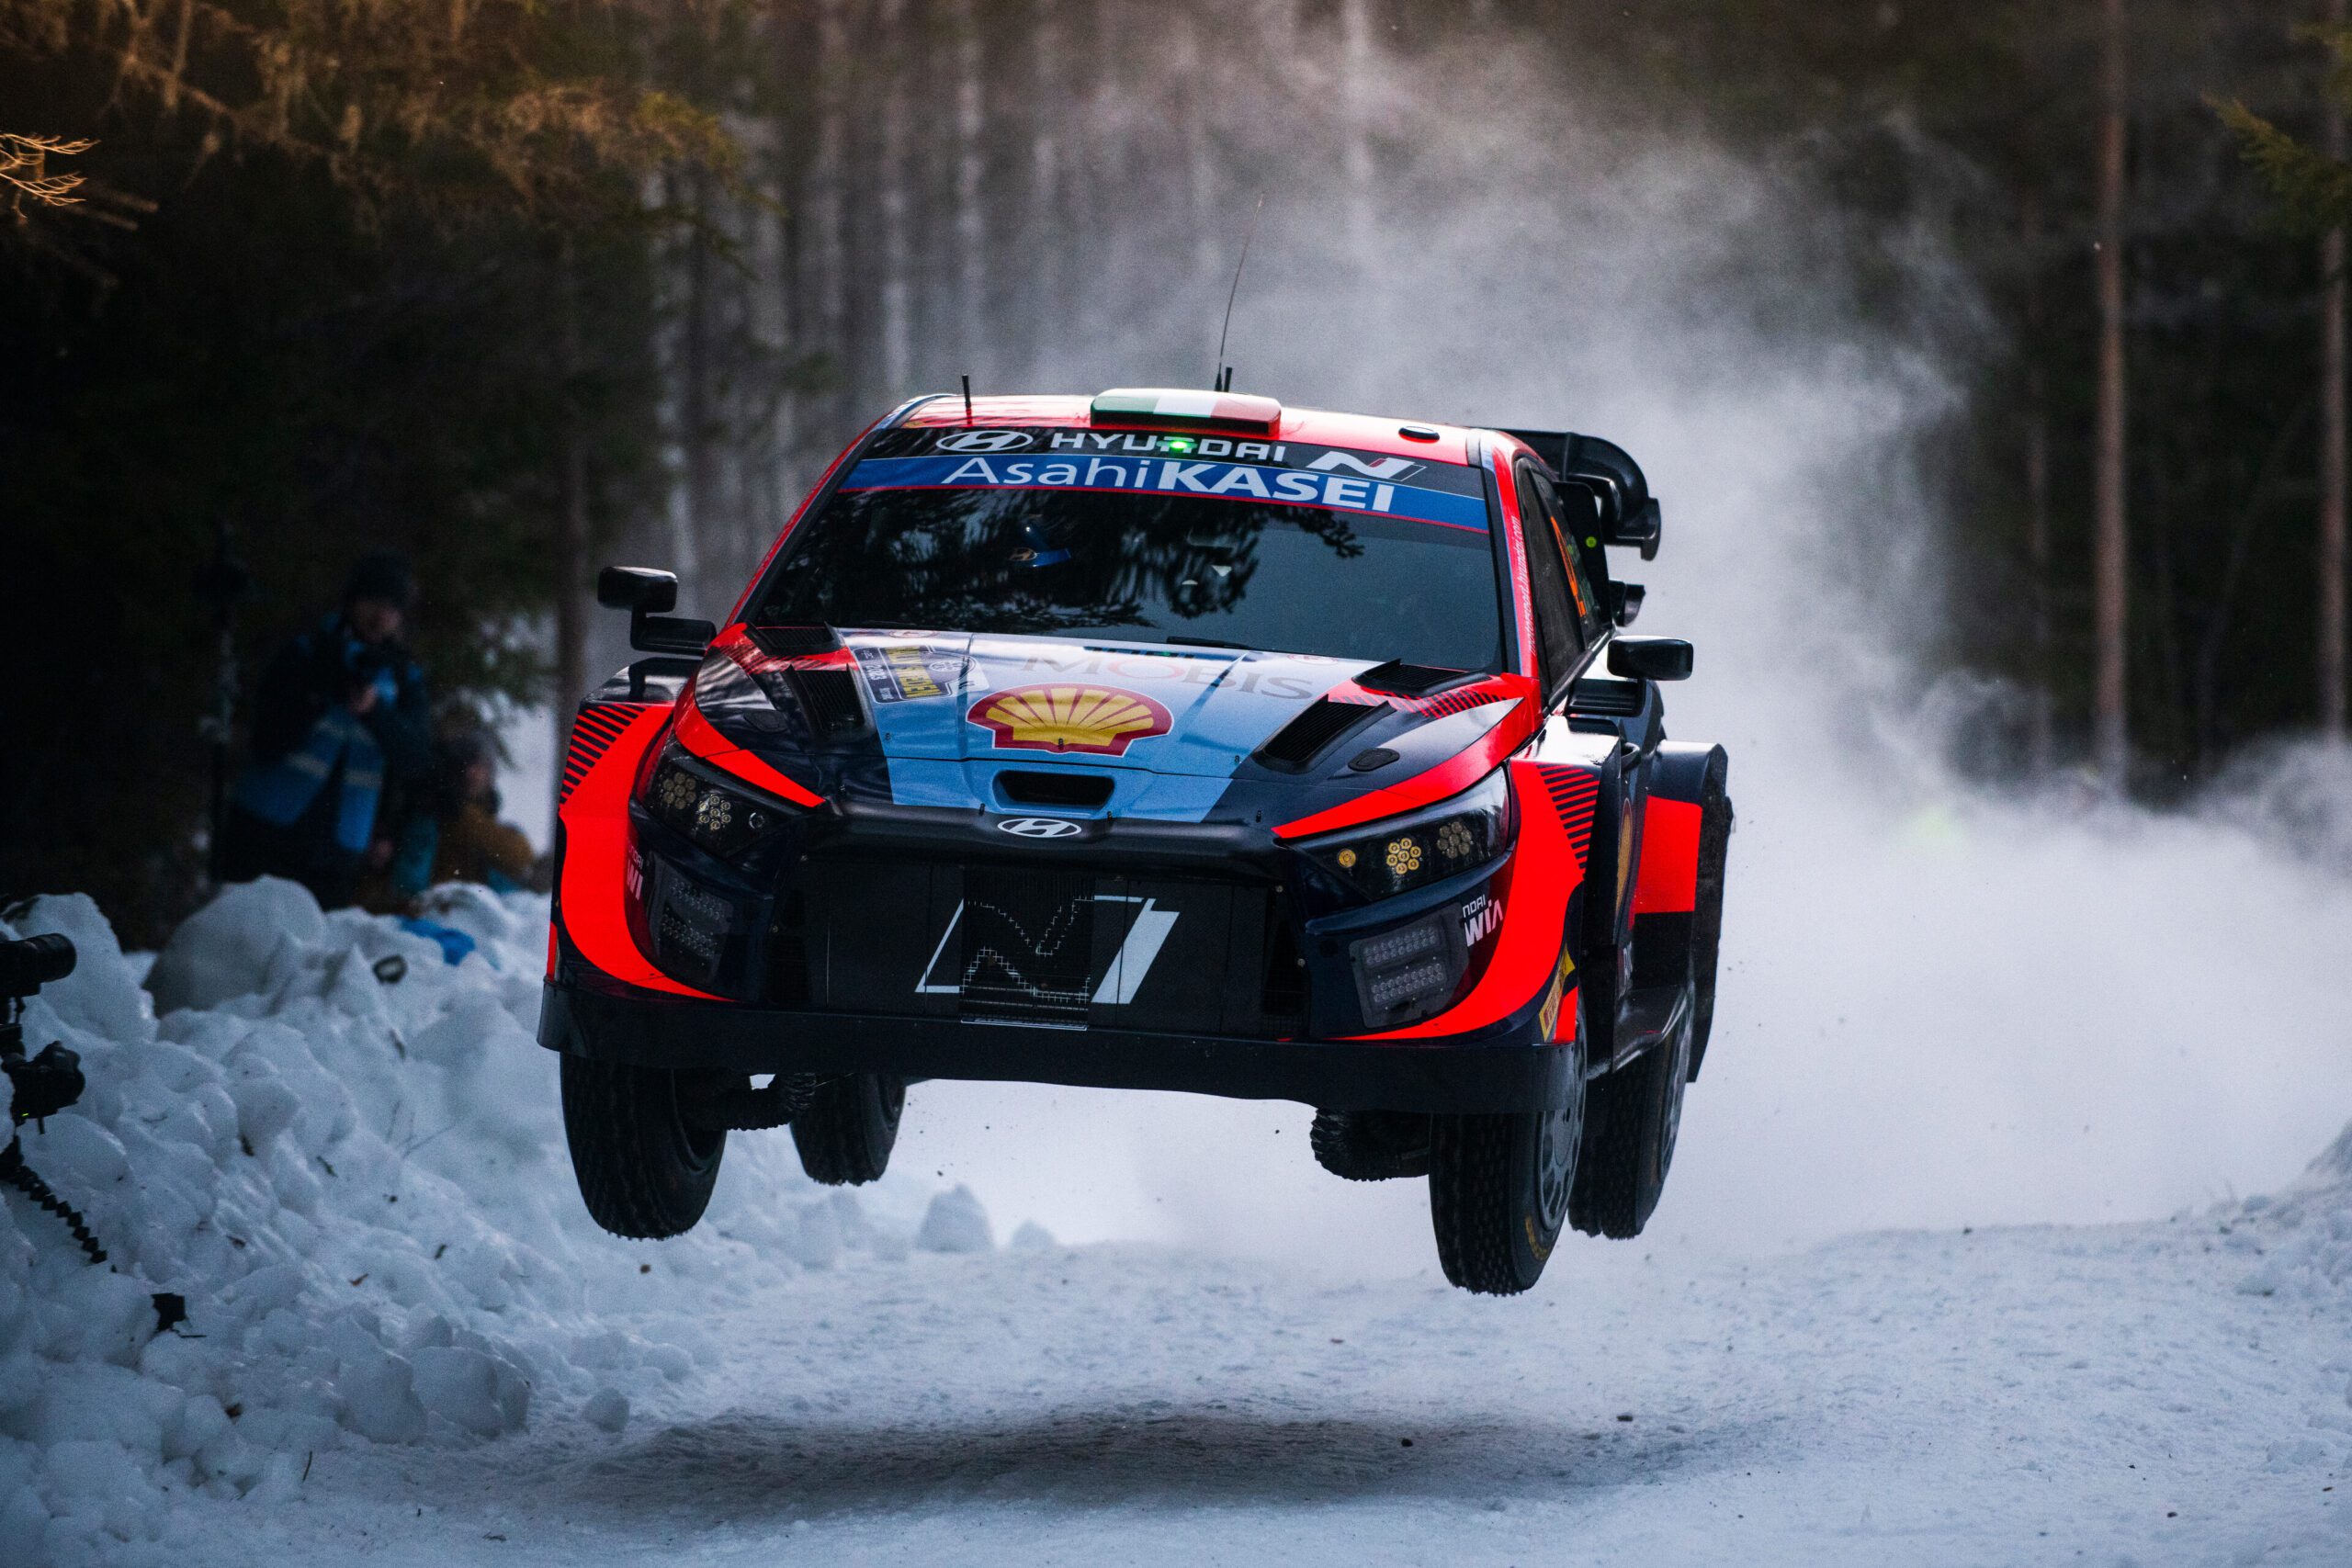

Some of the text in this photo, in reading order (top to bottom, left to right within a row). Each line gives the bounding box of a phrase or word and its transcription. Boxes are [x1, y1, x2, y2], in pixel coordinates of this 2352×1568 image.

[1050, 433, 1287, 462] HYUNDAI
[866, 664, 888, 681] 2023
[1020, 655, 1314, 700] MOBIS
